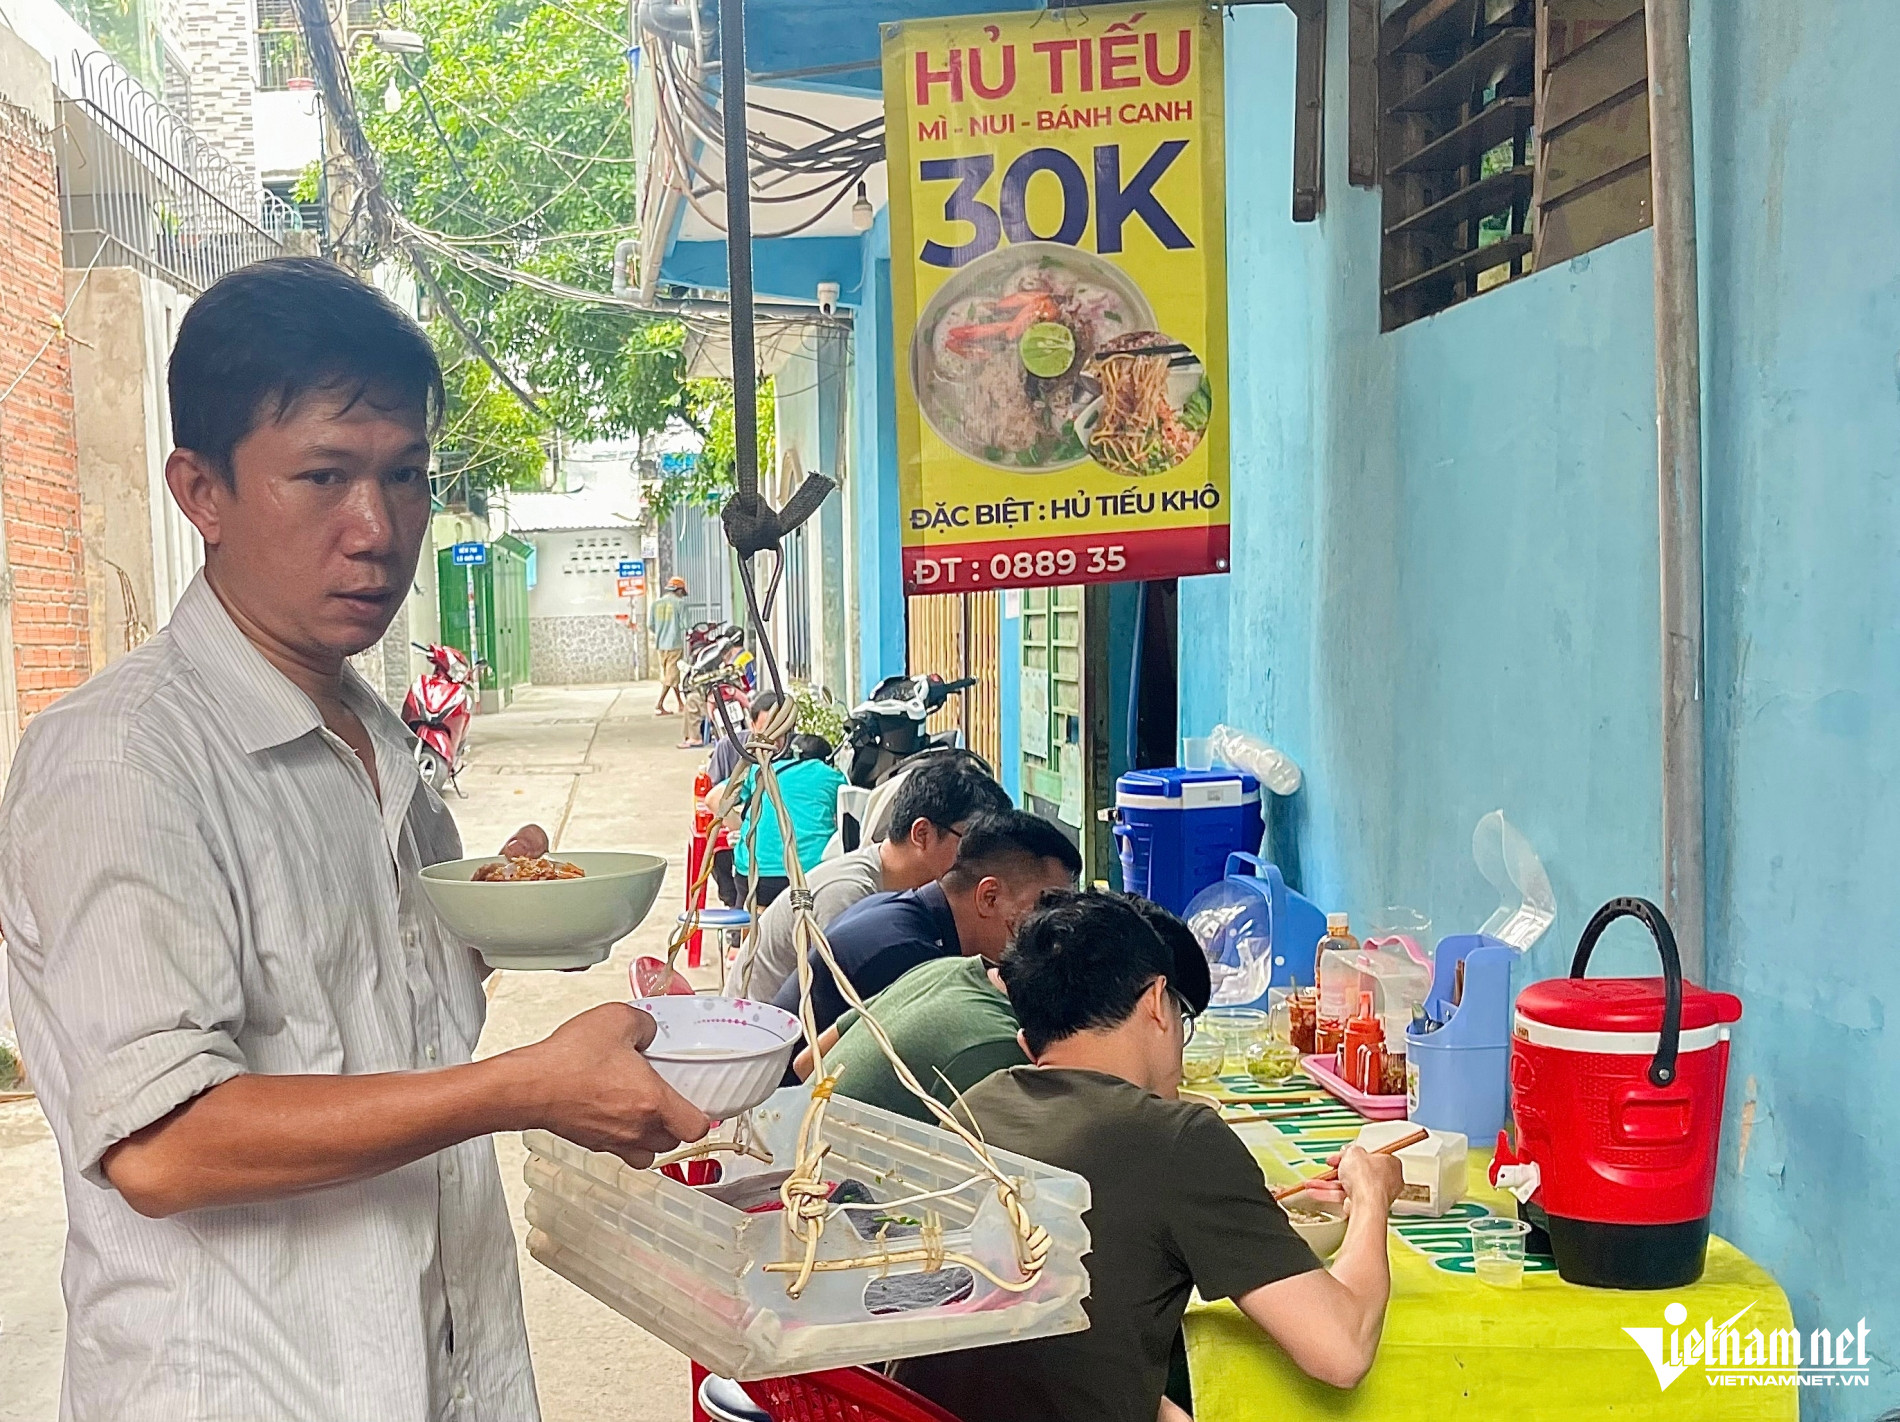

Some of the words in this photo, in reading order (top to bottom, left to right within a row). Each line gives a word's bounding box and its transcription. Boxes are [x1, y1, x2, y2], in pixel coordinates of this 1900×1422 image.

[915, 25, 1016, 105] HỦ
[1033, 12, 1191, 94] TIẾU
[918, 115, 948, 142] MÌ
[970, 113, 1015, 137] NUI
[1037, 105, 1112, 131] BÁNH
[1119, 100, 1193, 124] CANH
[919, 140, 1195, 268] 30K
[909, 502, 970, 534] ĐẶC
[976, 497, 1035, 529] BIỆT
[1051, 489, 1091, 520] HỦ
[1096, 486, 1155, 517] TIẾU
[1162, 484, 1220, 512] KHÔ
[913, 557, 963, 585] ĐT
[990, 549, 1077, 580] 0889
[1086, 546, 1126, 575] 35
